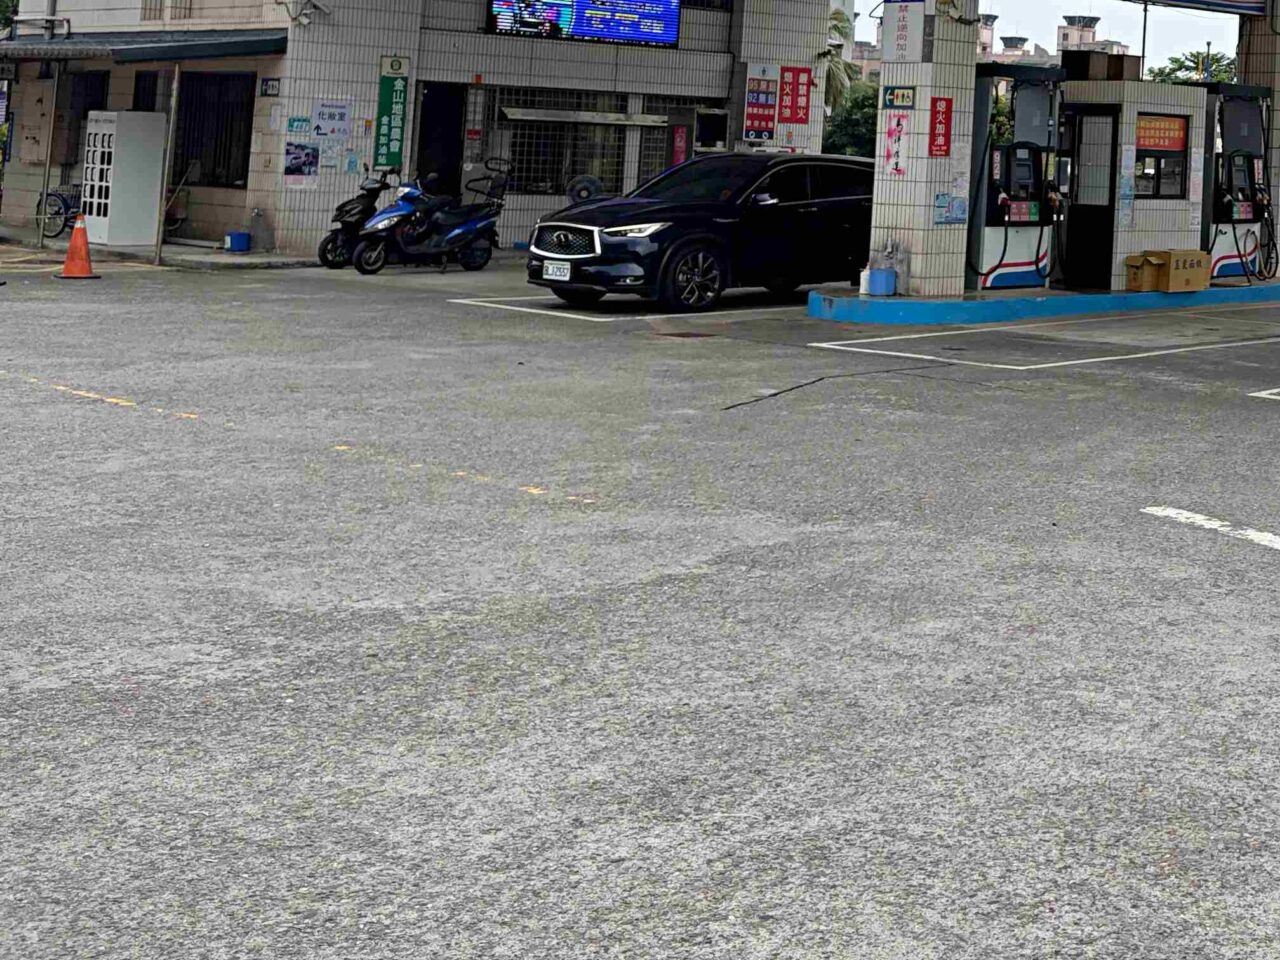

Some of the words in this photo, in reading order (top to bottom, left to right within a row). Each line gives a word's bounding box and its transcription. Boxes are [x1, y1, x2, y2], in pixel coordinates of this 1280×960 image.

[389, 77, 406, 153] 金山地區農會
